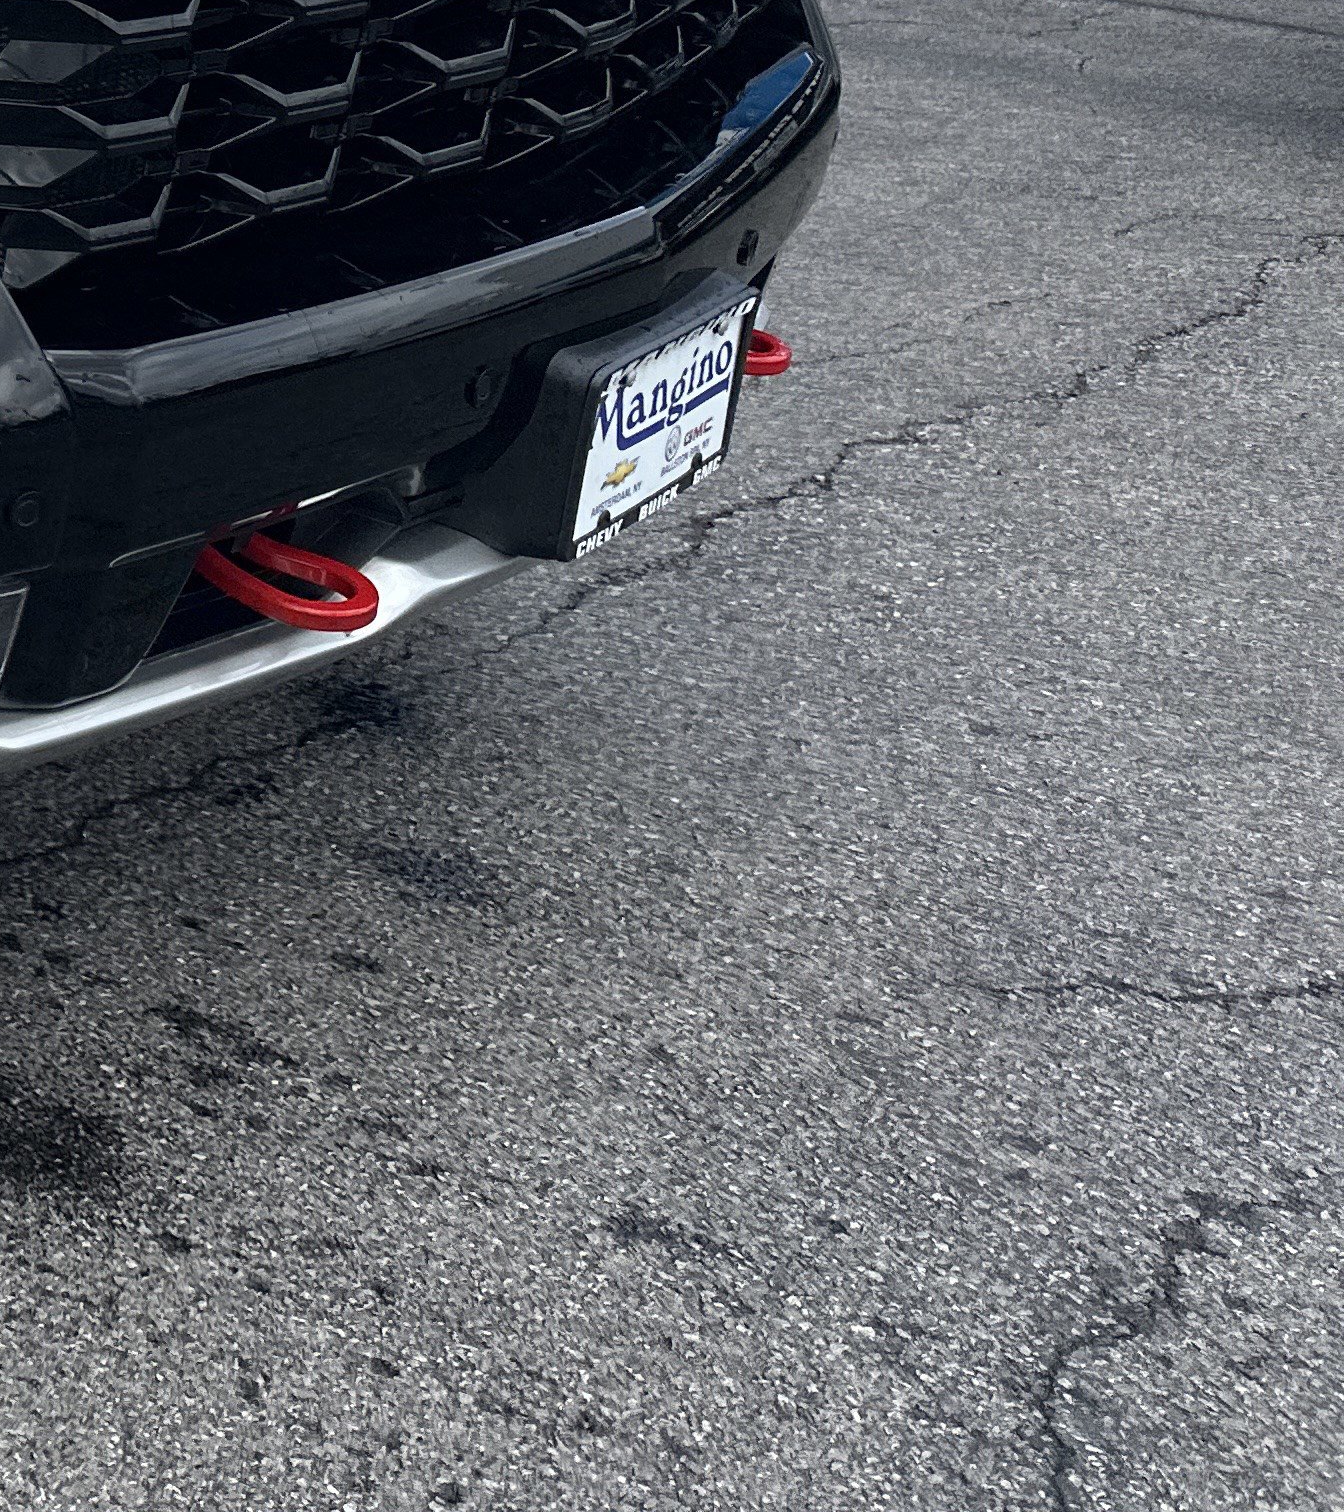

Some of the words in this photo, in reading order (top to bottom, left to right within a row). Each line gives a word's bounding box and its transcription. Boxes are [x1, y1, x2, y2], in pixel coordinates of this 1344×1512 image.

[596, 340, 733, 451] Mangino
[683, 416, 713, 446] GMC
[576, 518, 624, 559] CHEVY
[638, 484, 679, 522] BUICK
[692, 455, 722, 485] GMC
